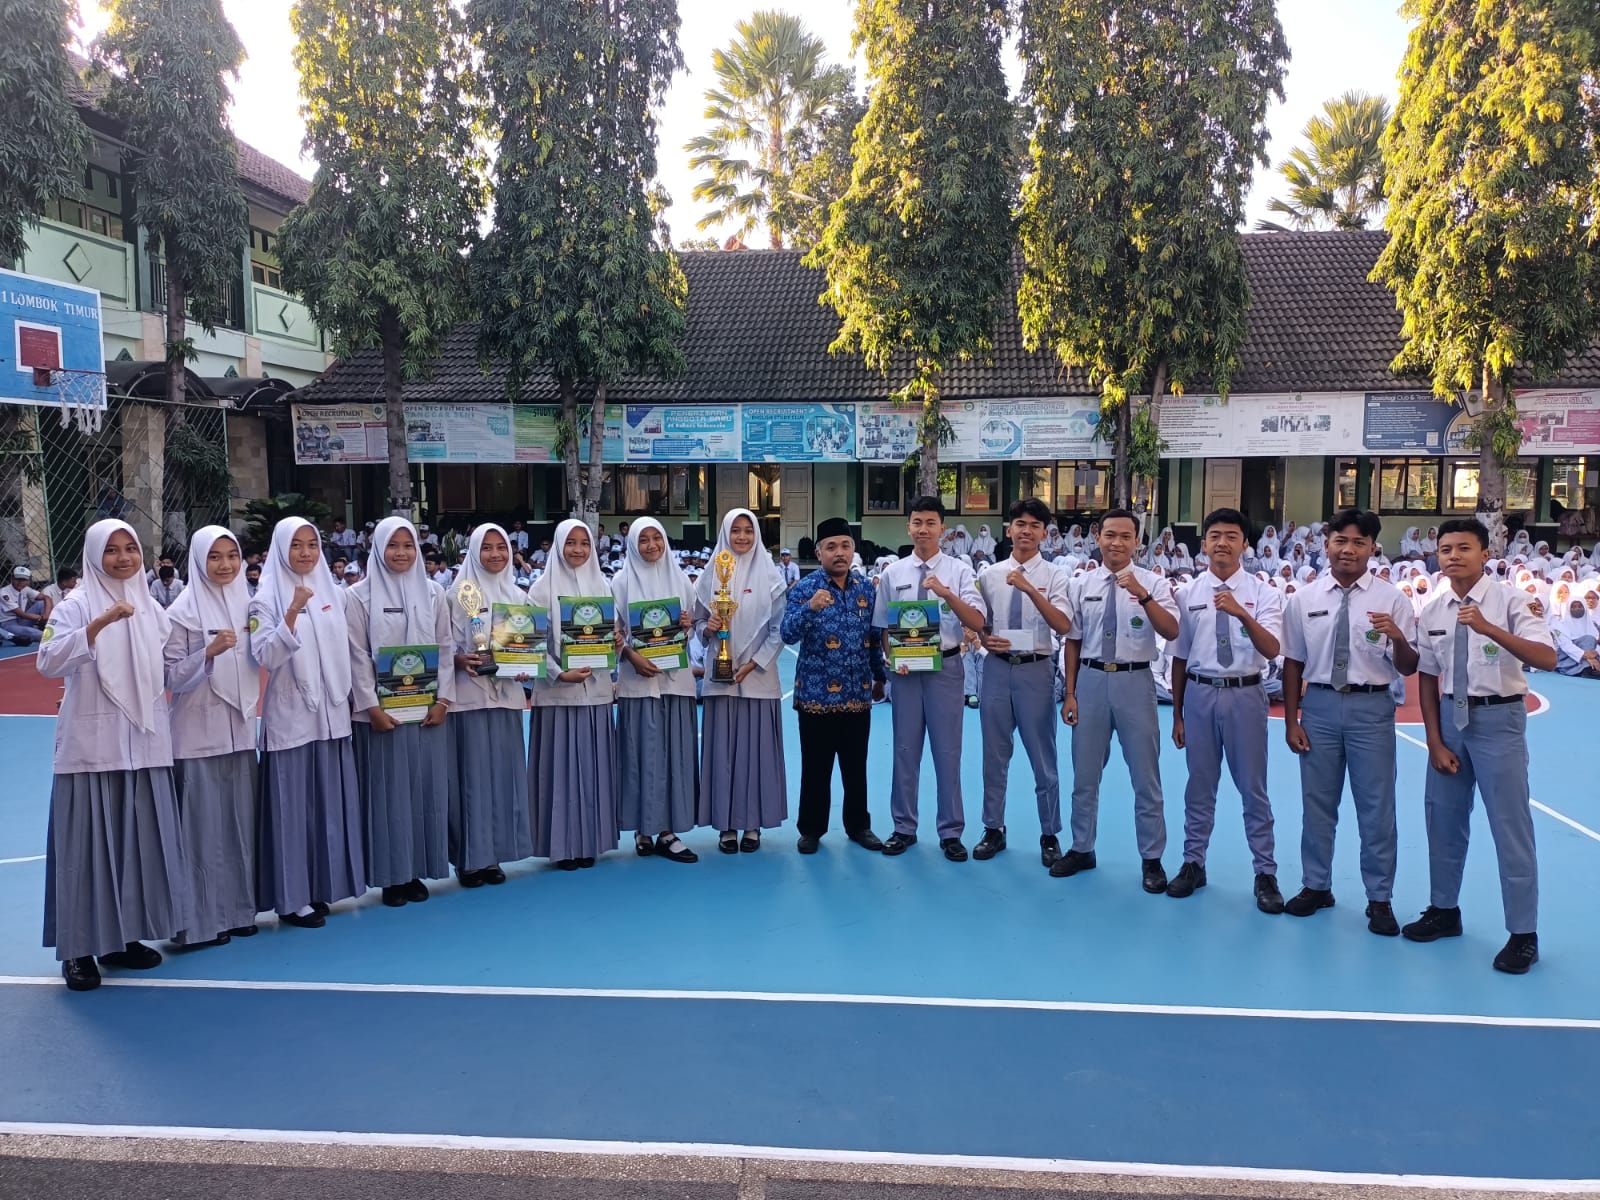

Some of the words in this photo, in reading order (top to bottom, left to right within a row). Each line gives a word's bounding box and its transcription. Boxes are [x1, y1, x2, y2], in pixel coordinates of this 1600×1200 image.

[1, 290, 8, 303] 1
[10, 291, 59, 313] LOMBOK
[63, 302, 99, 320] TIMUR
[320, 409, 364, 417] RECRUITMENT
[533, 408, 551, 417] STUDY
